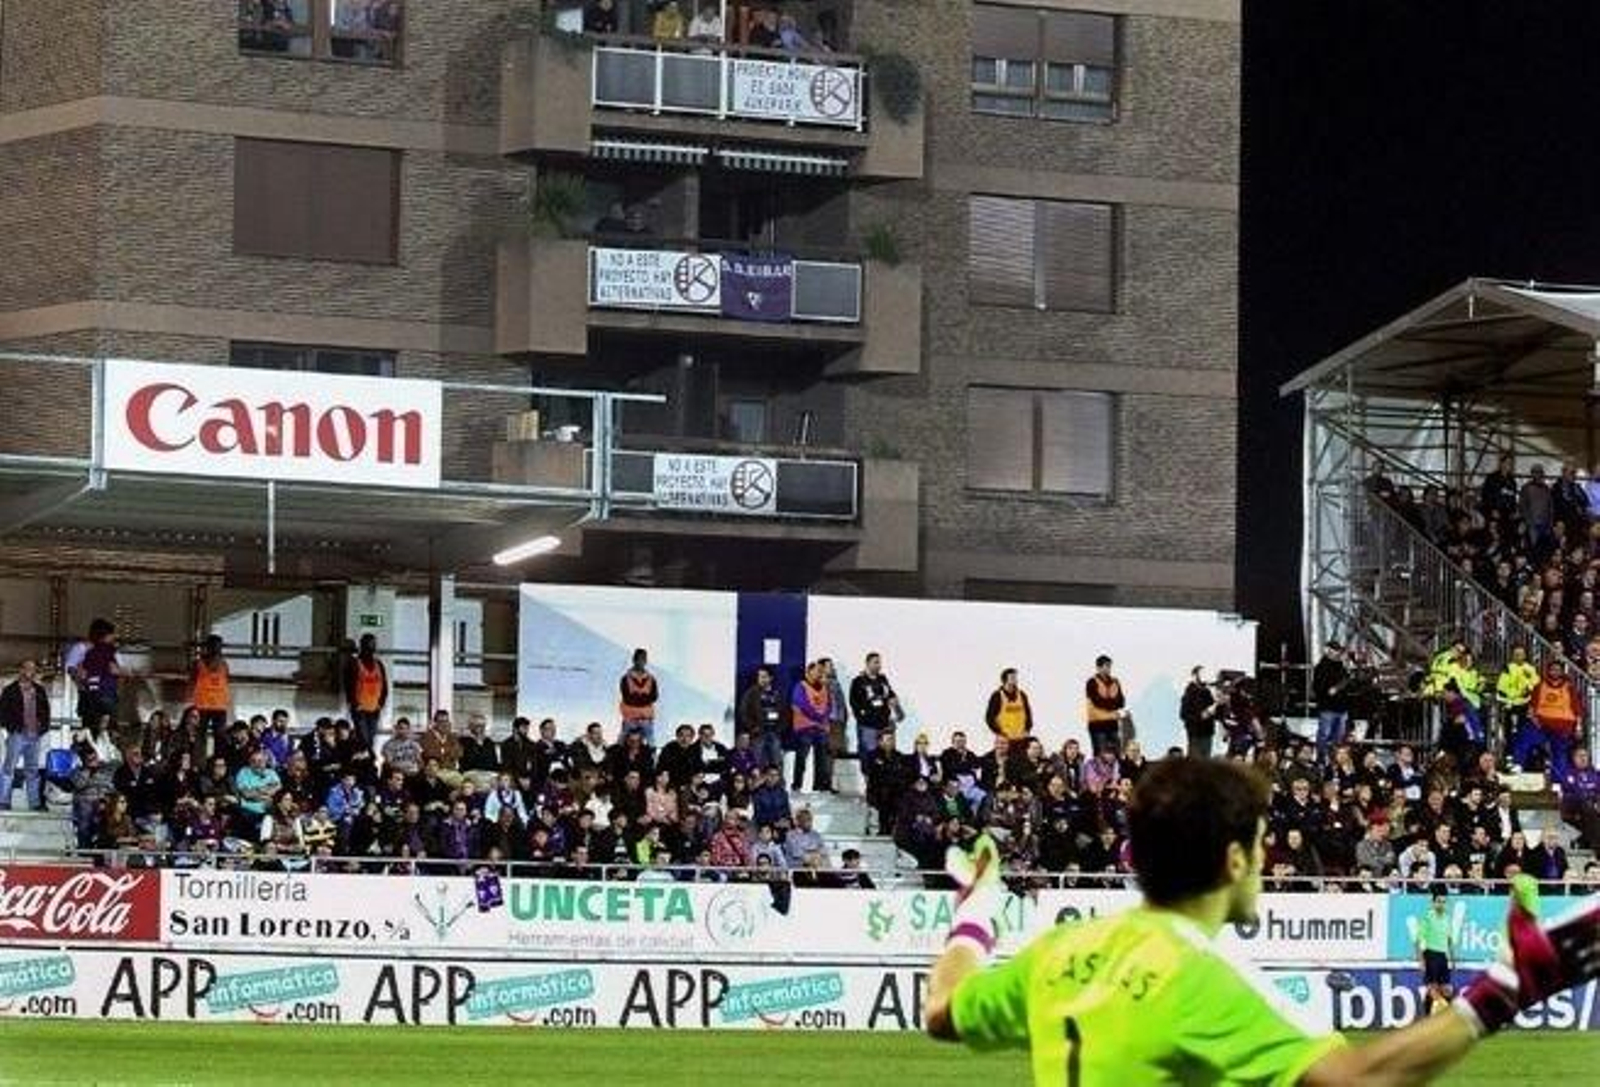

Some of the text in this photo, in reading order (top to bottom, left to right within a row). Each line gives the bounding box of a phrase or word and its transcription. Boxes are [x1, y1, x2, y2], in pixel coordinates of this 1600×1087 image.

[610, 253, 624, 267] NO
[126, 382, 423, 465] Canon
[668, 459, 681, 473] NO
[510, 883, 694, 923] UNCETA
[170, 911, 229, 936] San
[1267, 909, 1374, 940] hummel
[20, 994, 77, 1016] .com
[101, 957, 217, 1019] APP
[286, 1001, 341, 1022] .com
[363, 964, 476, 1025] APP
[542, 1006, 596, 1028] .com
[618, 969, 729, 1028] APP
[794, 1009, 846, 1030] .com
